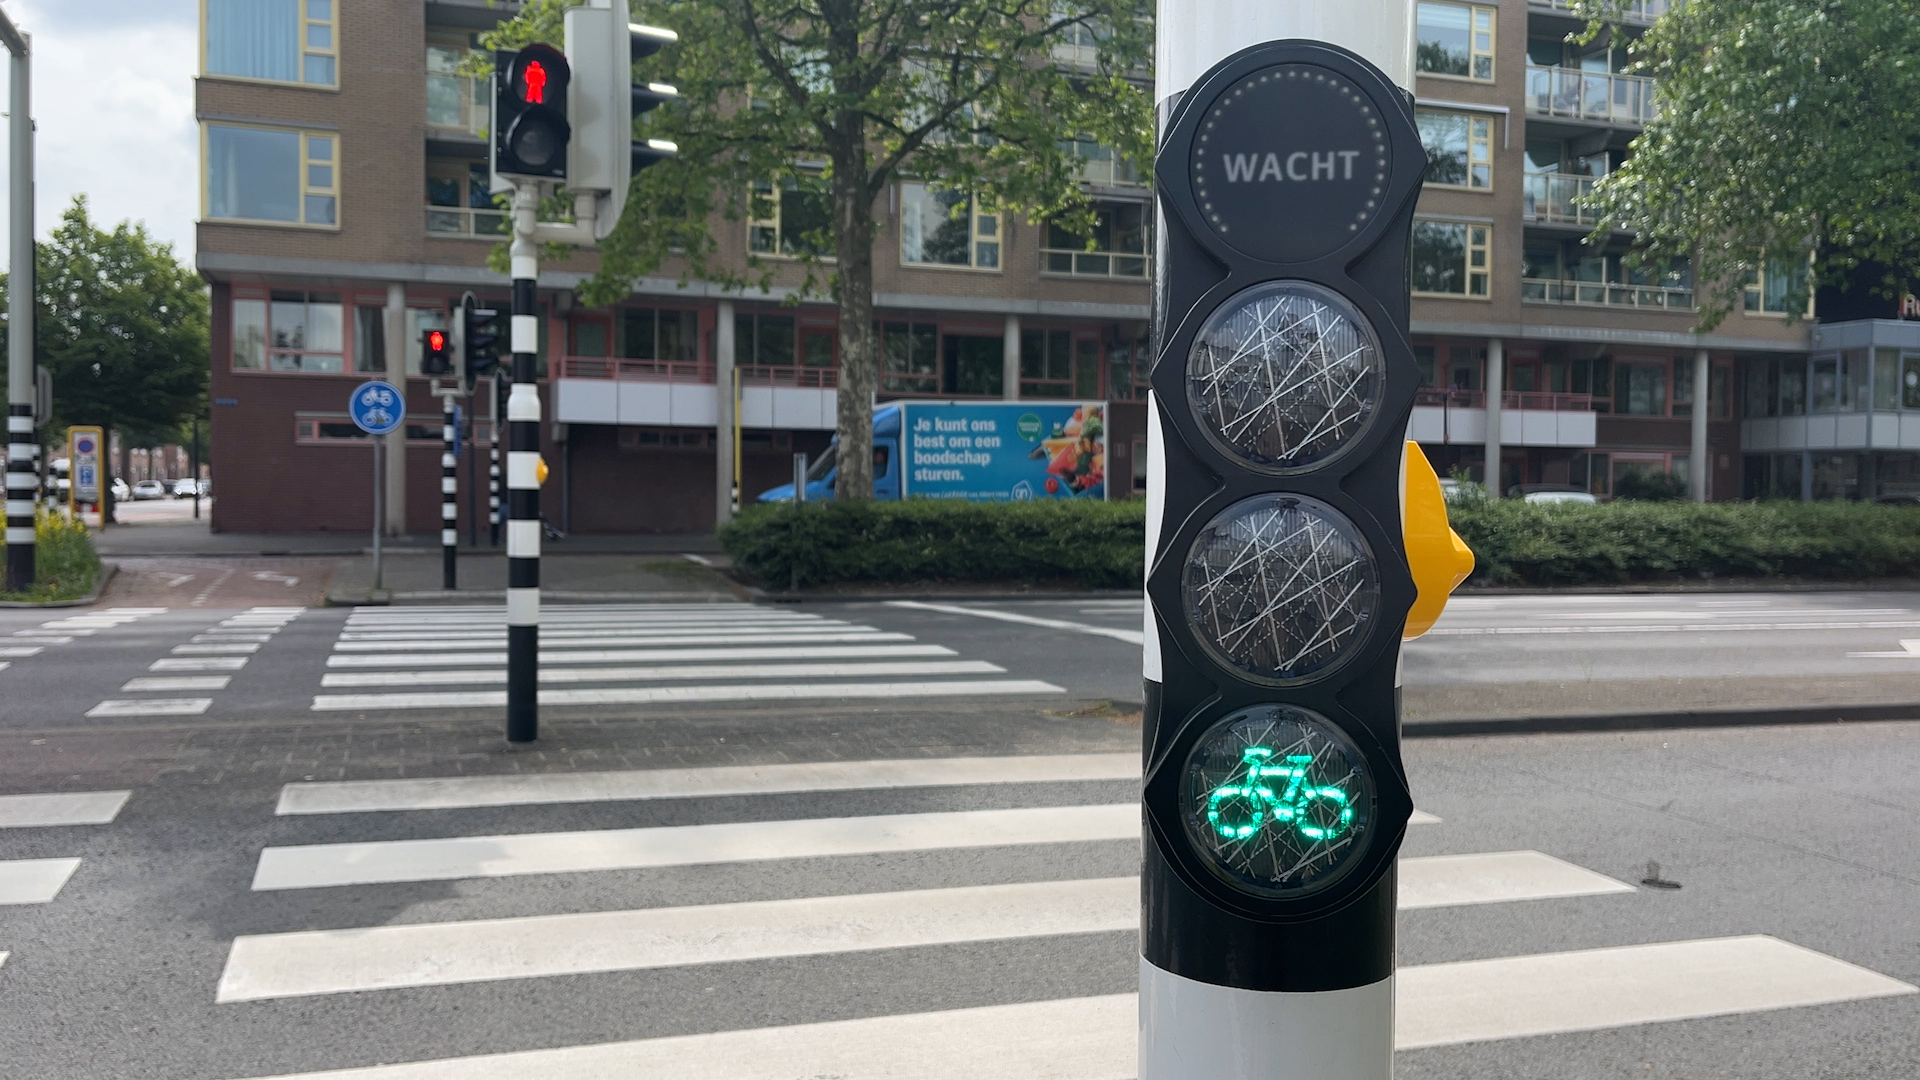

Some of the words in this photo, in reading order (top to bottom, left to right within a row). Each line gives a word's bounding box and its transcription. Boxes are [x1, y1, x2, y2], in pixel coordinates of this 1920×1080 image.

[1222, 150, 1361, 183] WACHT
[913, 417, 931, 432] Je
[934, 416, 968, 432] kunt
[970, 420, 996, 432] ons
[913, 433, 945, 448] best
[948, 436, 971, 448] om
[974, 436, 1001, 448] een
[913, 450, 991, 467] boodschap
[914, 467, 965, 481] sturen.
